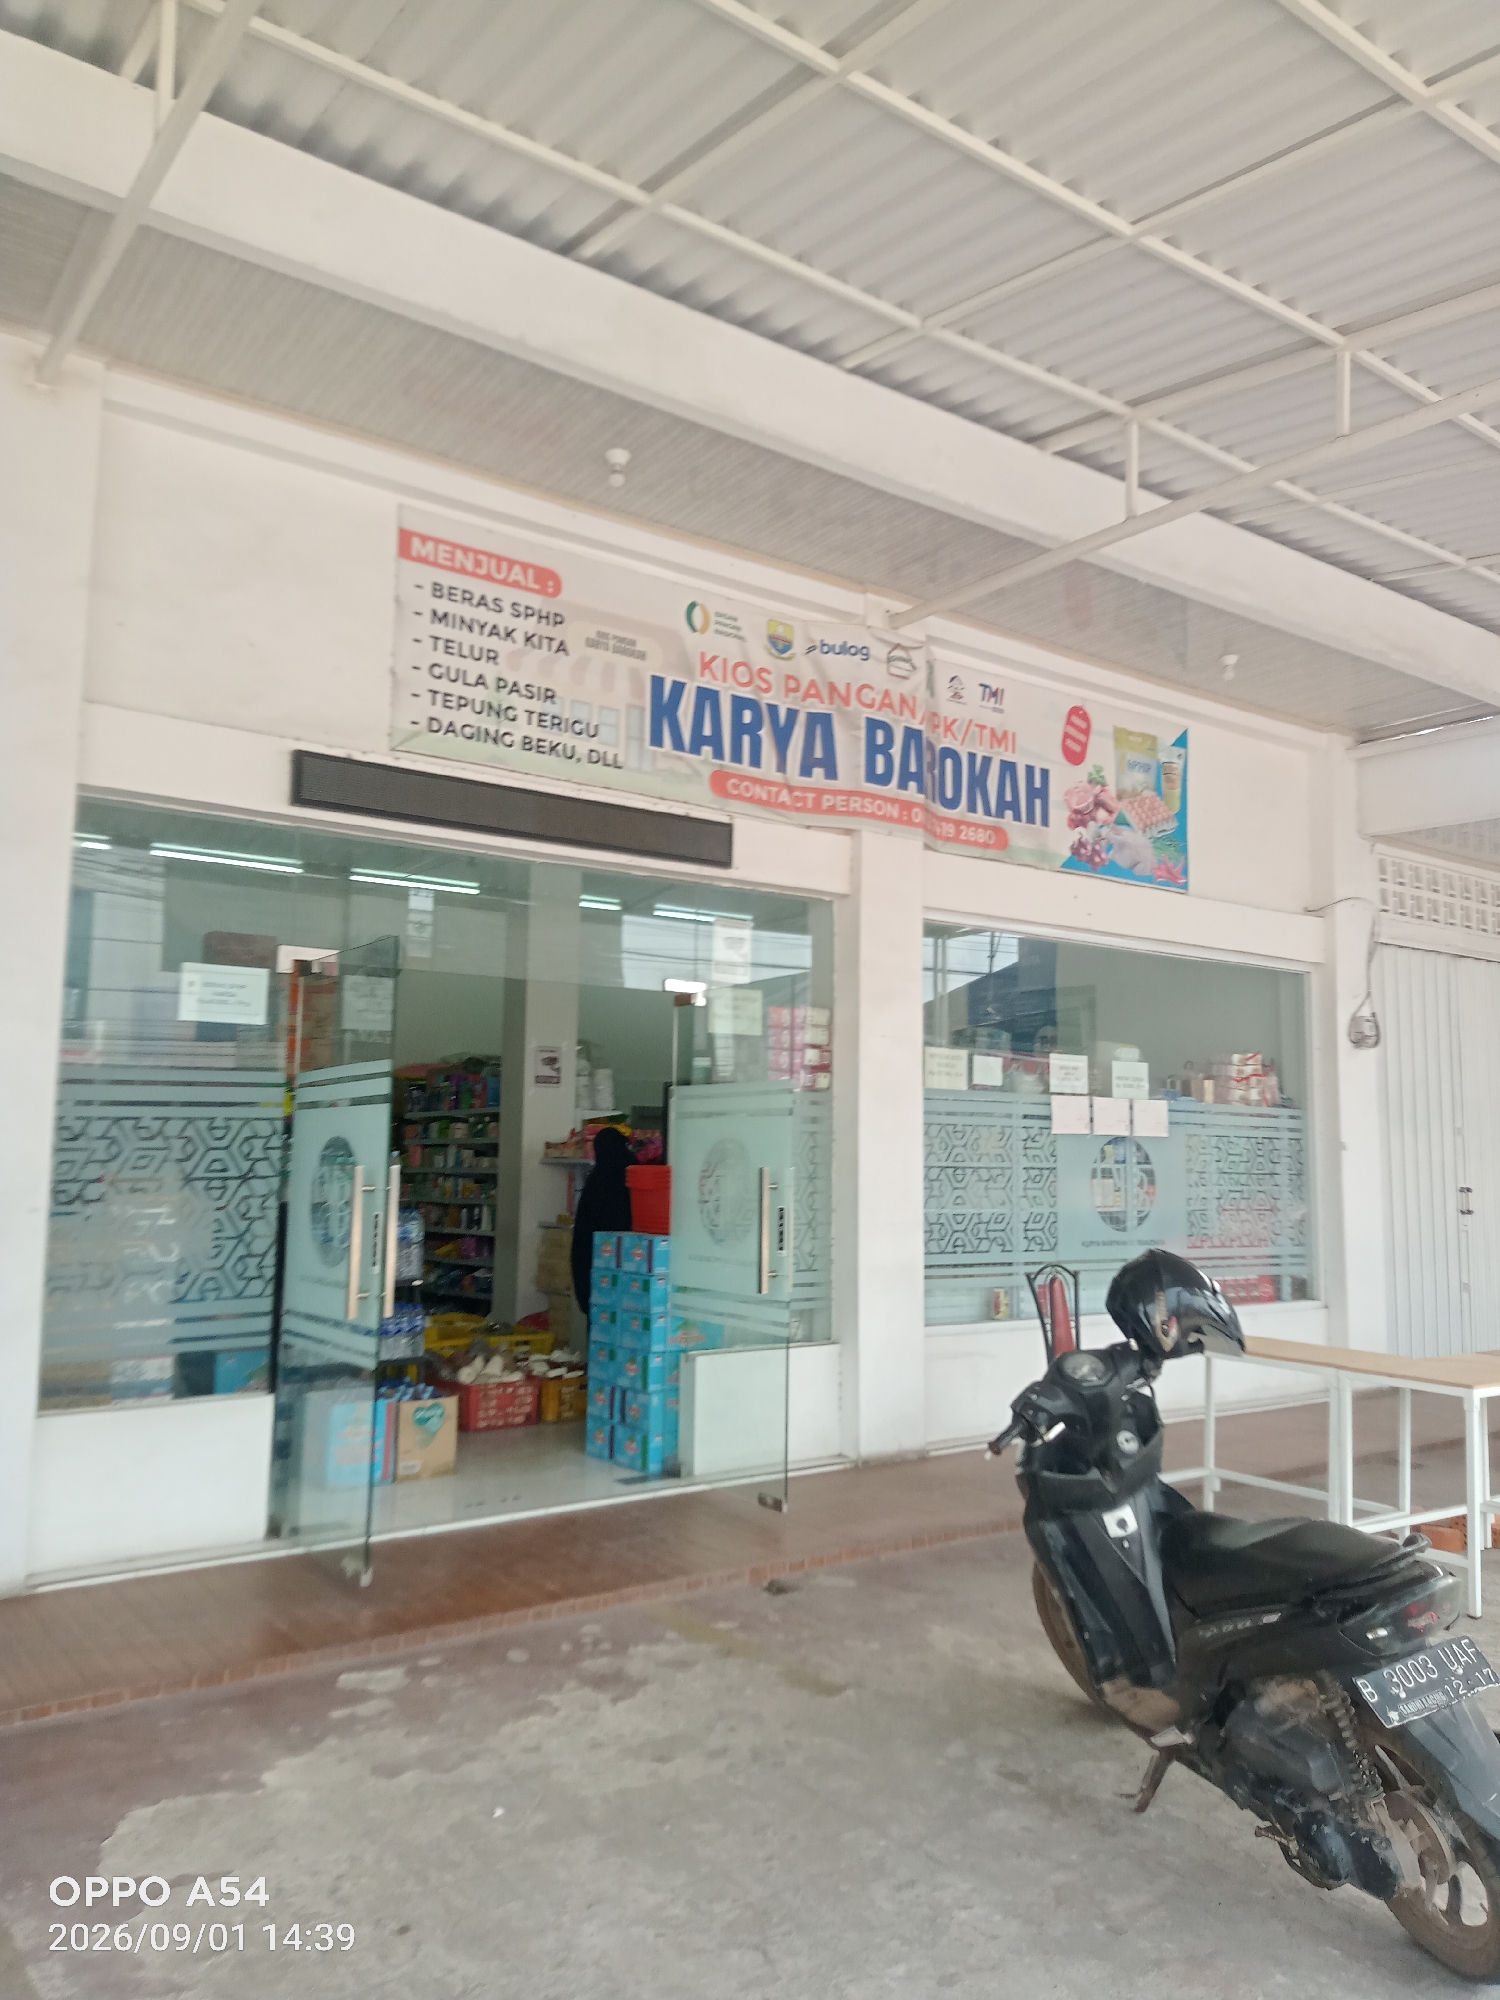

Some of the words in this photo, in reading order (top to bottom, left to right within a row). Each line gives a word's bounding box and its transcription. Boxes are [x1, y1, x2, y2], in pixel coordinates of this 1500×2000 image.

[410, 537, 542, 591] MENJUAL
[431, 582, 505, 613] BERAS
[510, 602, 566, 628] SPHP
[430, 636, 500, 665] TELUR
[431, 608, 518, 644] MINYAK
[523, 631, 570, 656] KITA
[820, 639, 870, 661] bulog
[429, 662, 489, 690] GULA
[495, 677, 558, 705] PASIR
[699, 651, 773, 694] KIOS
[979, 682, 1006, 706] TMI
[428, 688, 518, 722] TEPUNG
[525, 709, 600, 739] TERIGU
[427, 716, 515, 748] DAGING
[522, 735, 582, 764] BEKU,
[588, 750, 624, 769] DLL
[649, 674, 839, 782] KARYA
[864, 715, 1051, 829] BAROKAH
[726, 778, 816, 809] CONTACT
[822, 792, 899, 819] PERSON
[1356, 1678, 1379, 1702] B
[1383, 1655, 1438, 1692] 3003
[1437, 1639, 1477, 1671] UAF
